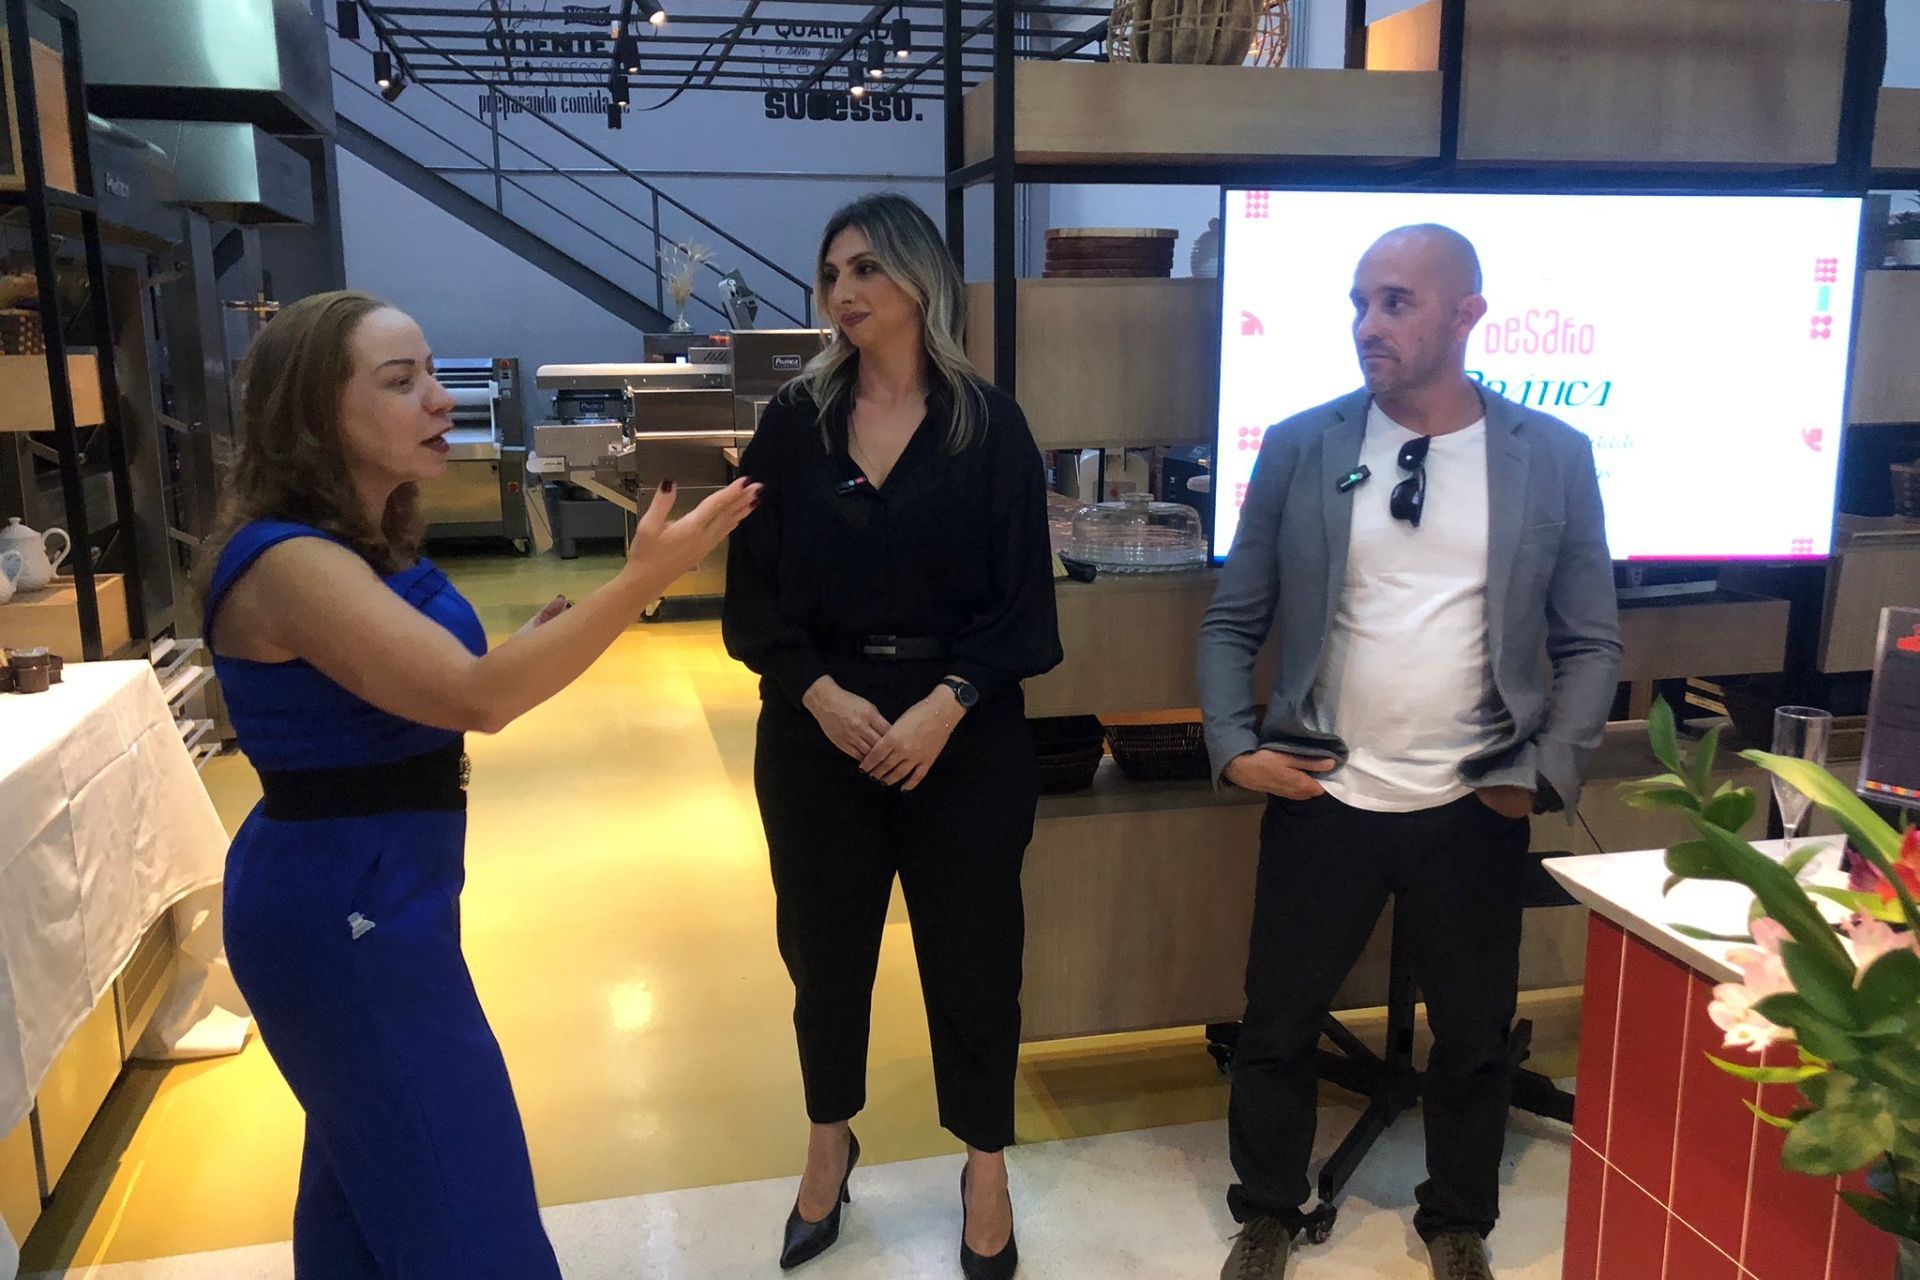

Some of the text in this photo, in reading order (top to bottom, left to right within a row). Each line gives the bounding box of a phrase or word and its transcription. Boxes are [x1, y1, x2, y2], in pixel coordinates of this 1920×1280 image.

[775, 22, 894, 39] QUALID
[479, 88, 609, 120] preparando comida
